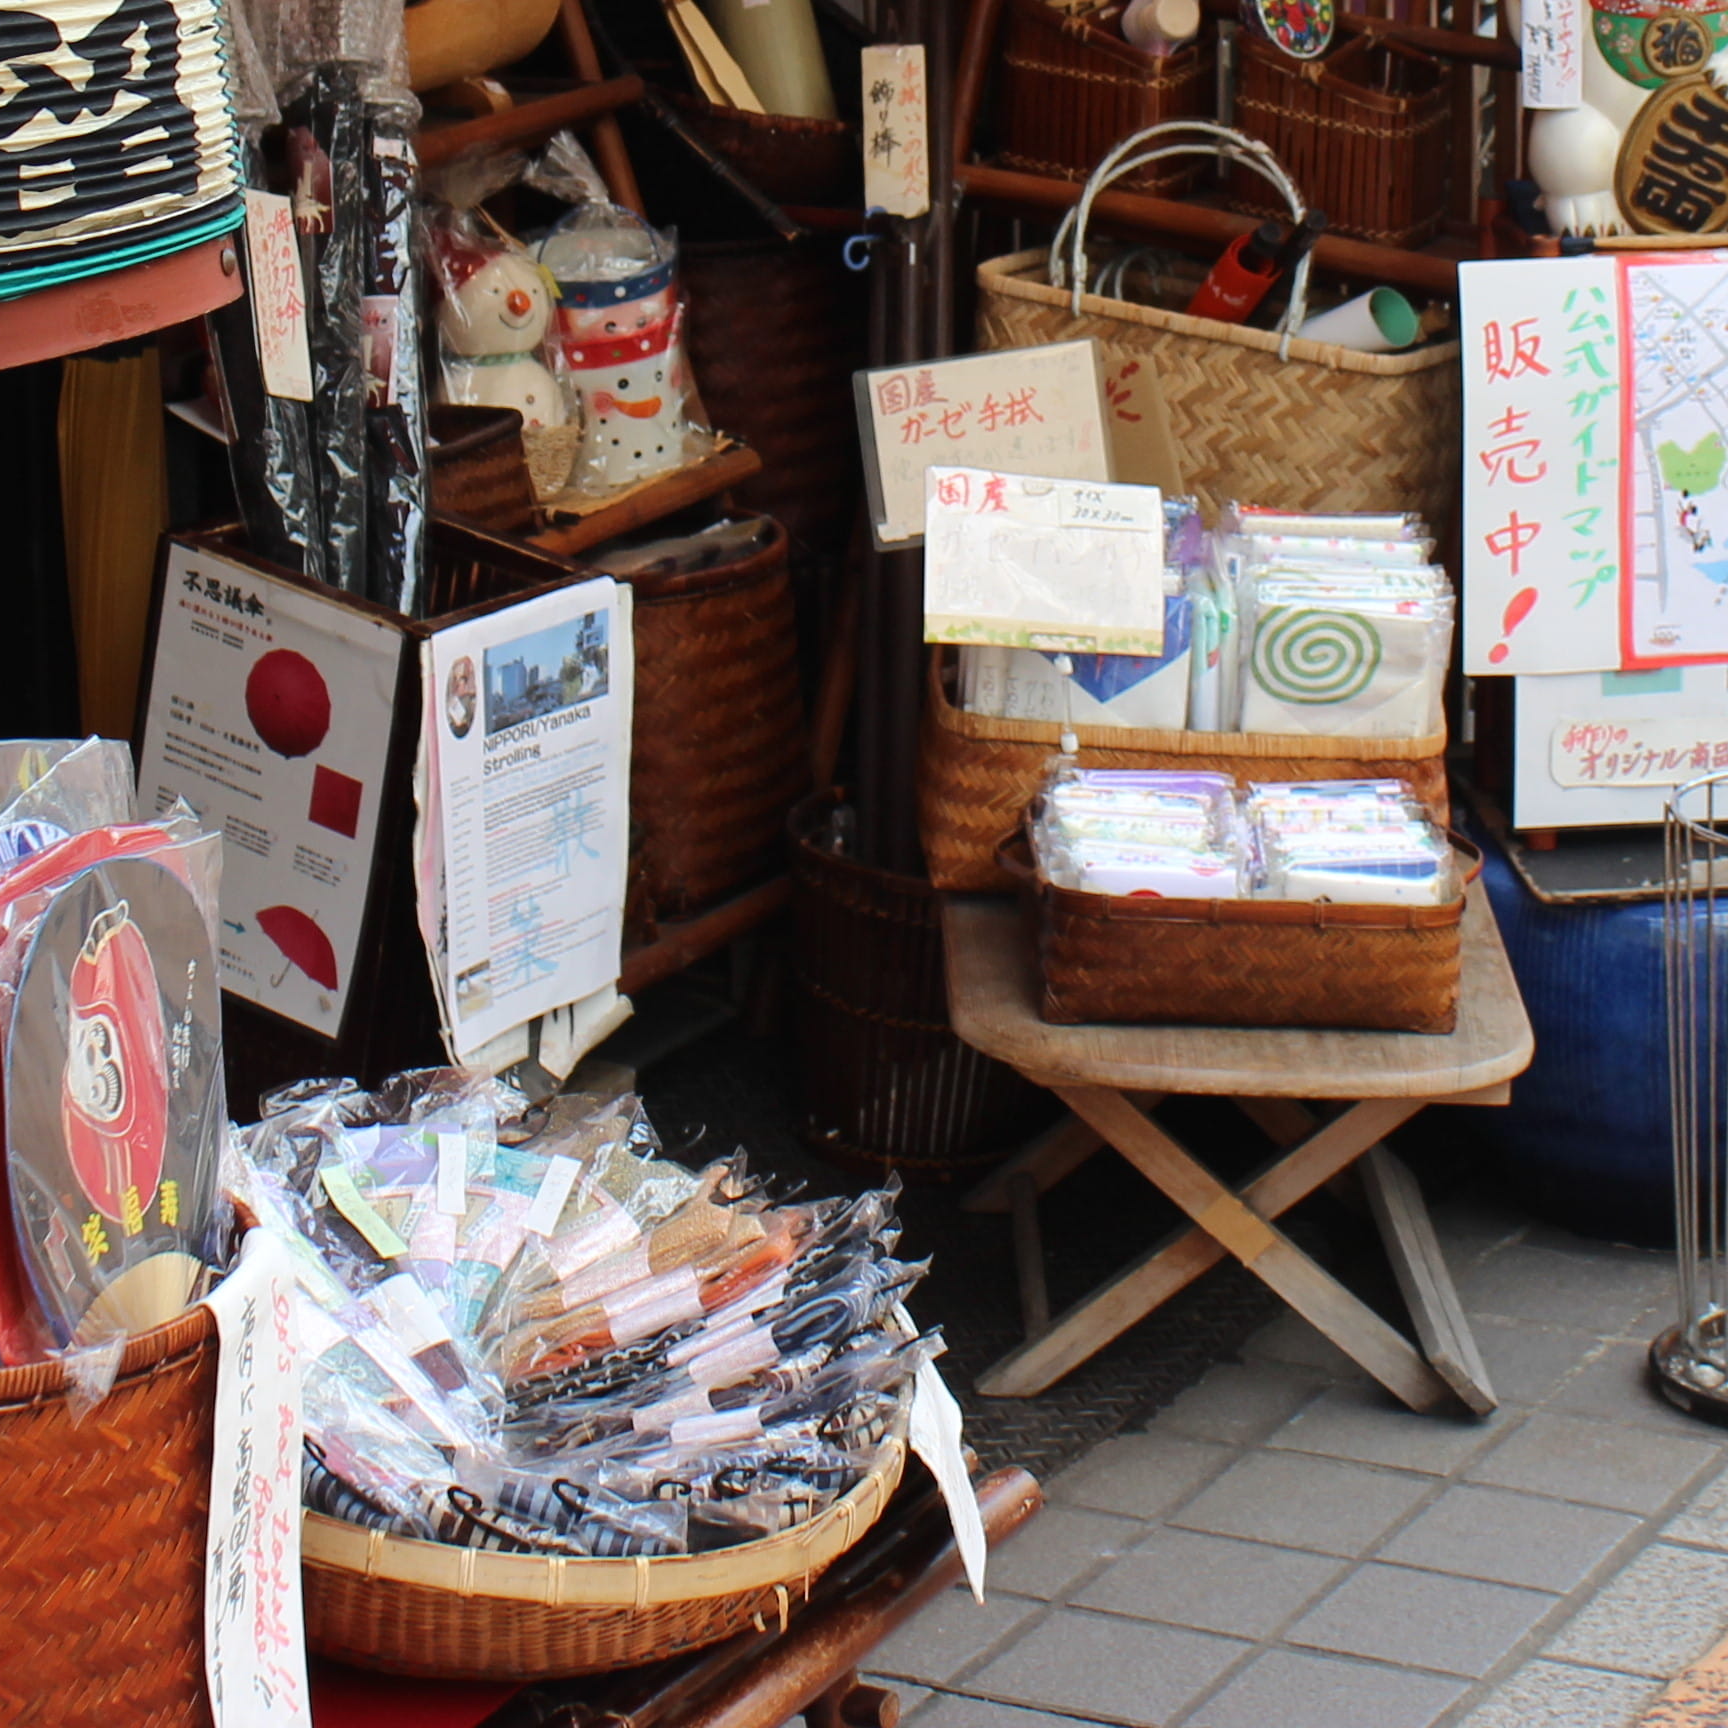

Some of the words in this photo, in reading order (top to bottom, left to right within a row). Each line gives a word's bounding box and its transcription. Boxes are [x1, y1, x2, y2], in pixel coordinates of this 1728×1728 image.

[876, 370, 950, 416] 国産
[934, 472, 1010, 516] 国産
[482, 704, 591, 756] NIPPORI/Yanaka
[482, 743, 542, 775] Strolling
